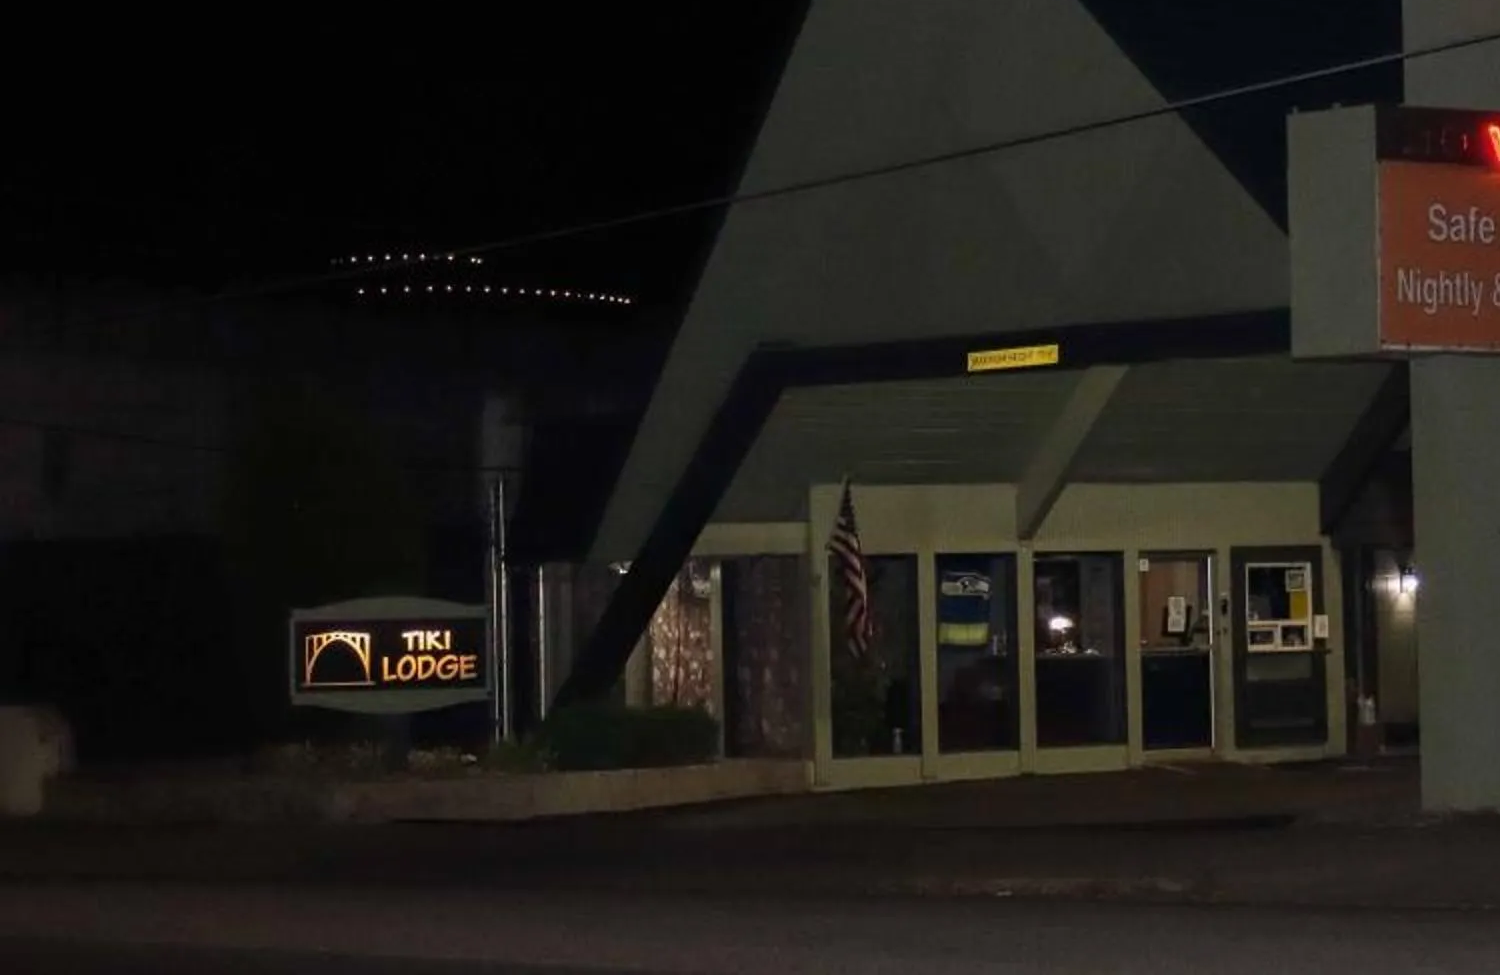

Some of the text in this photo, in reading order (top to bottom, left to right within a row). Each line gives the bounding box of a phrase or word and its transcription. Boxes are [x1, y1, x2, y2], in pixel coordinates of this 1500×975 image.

[1428, 203, 1495, 245] Safe
[1397, 267, 1484, 317] Nightly
[401, 629, 452, 652] TIKI
[381, 653, 479, 682] LODGE
